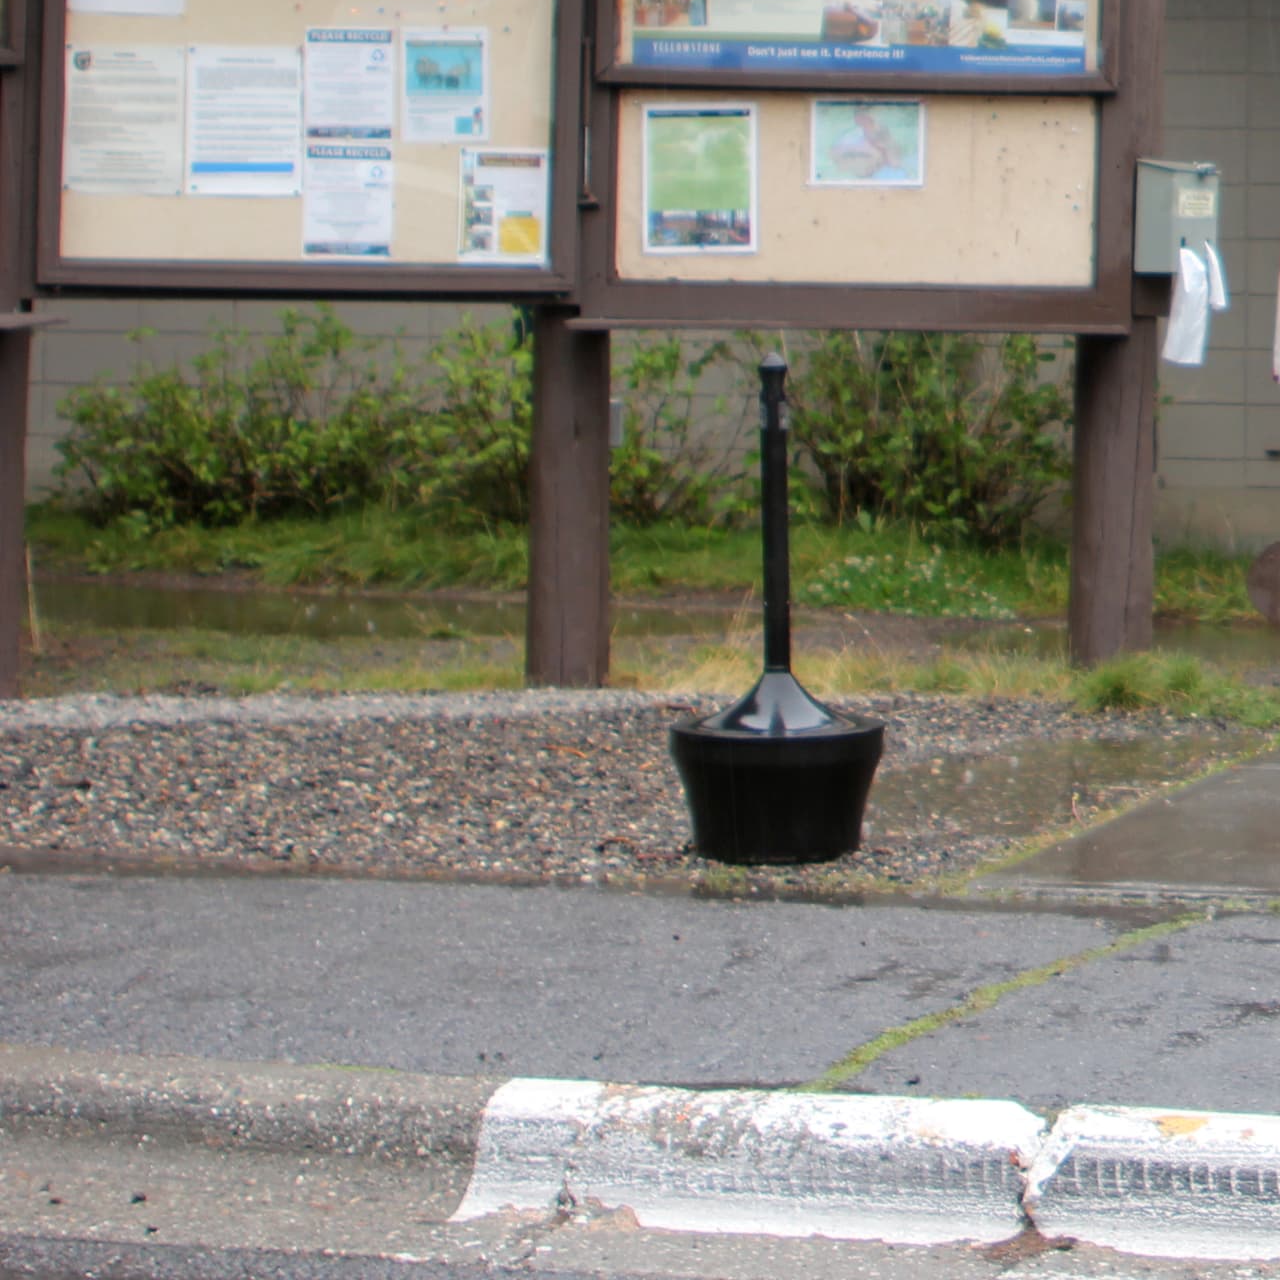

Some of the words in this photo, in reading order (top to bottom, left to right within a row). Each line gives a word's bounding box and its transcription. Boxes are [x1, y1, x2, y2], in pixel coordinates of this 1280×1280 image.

[311, 30, 344, 41] PLEASE
[652, 42, 721, 54] YELLOWSTONE
[747, 45, 775, 57] Don't
[777, 46, 797, 58] just
[800, 48, 818, 58] see
[834, 47, 890, 60] Experience
[310, 146, 343, 157] PLEASE
